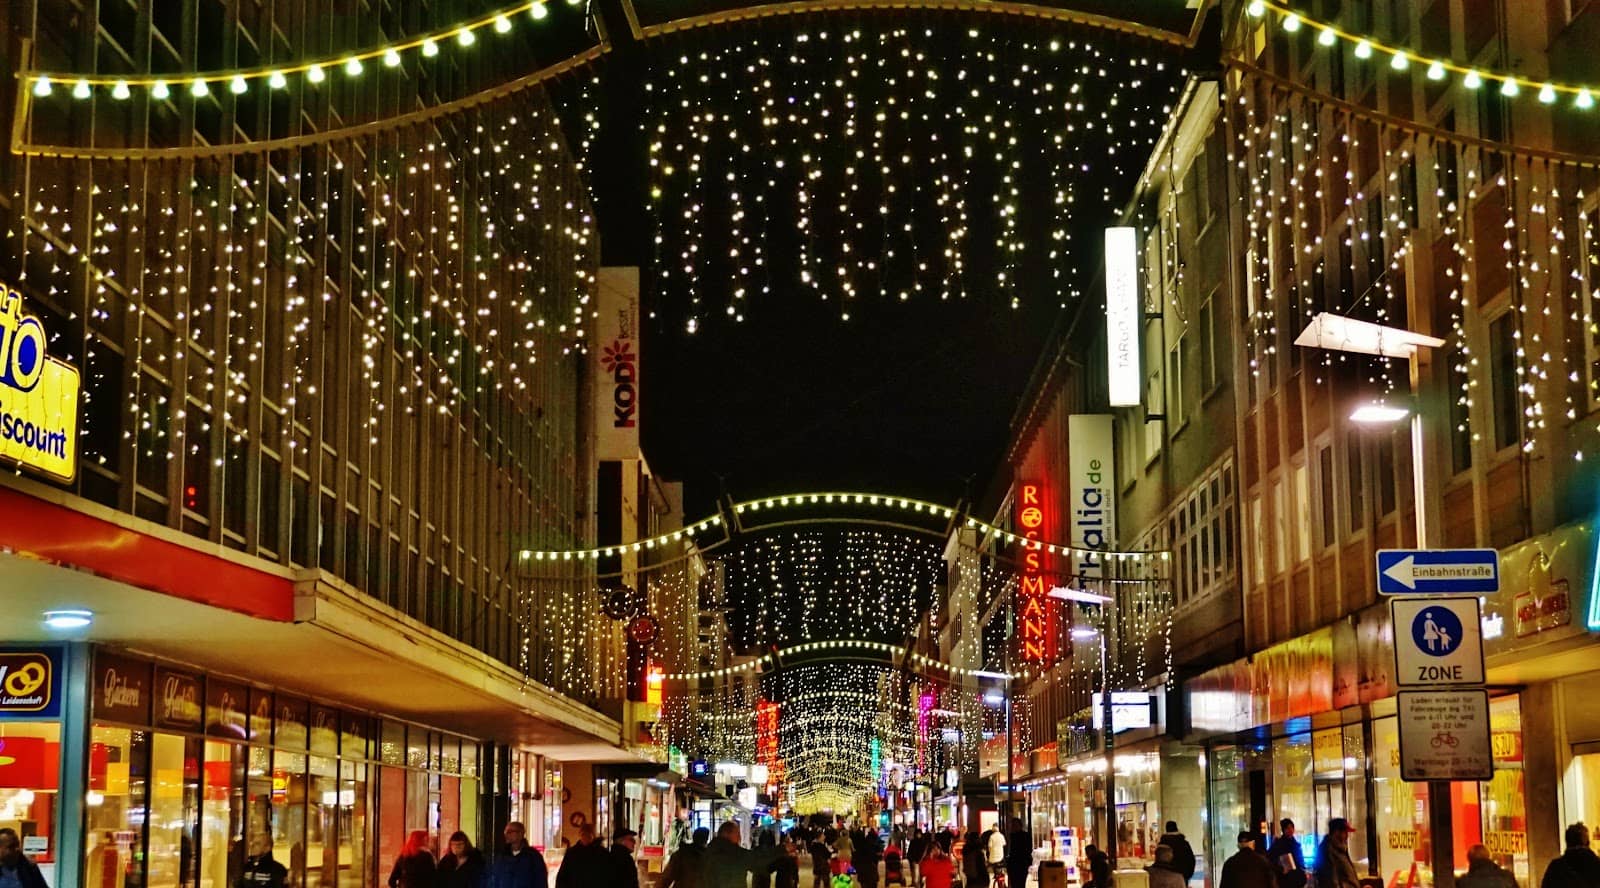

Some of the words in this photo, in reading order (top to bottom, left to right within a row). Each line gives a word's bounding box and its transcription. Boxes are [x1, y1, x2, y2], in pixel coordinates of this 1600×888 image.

[1412, 566, 1491, 577] Einbahnstraße
[1418, 666, 1463, 681] ZONE
[2, 696, 43, 705] Leidenschaft
[1388, 832, 1418, 850] REDUZIERT
[1484, 831, 1526, 856] REDUZIERT
